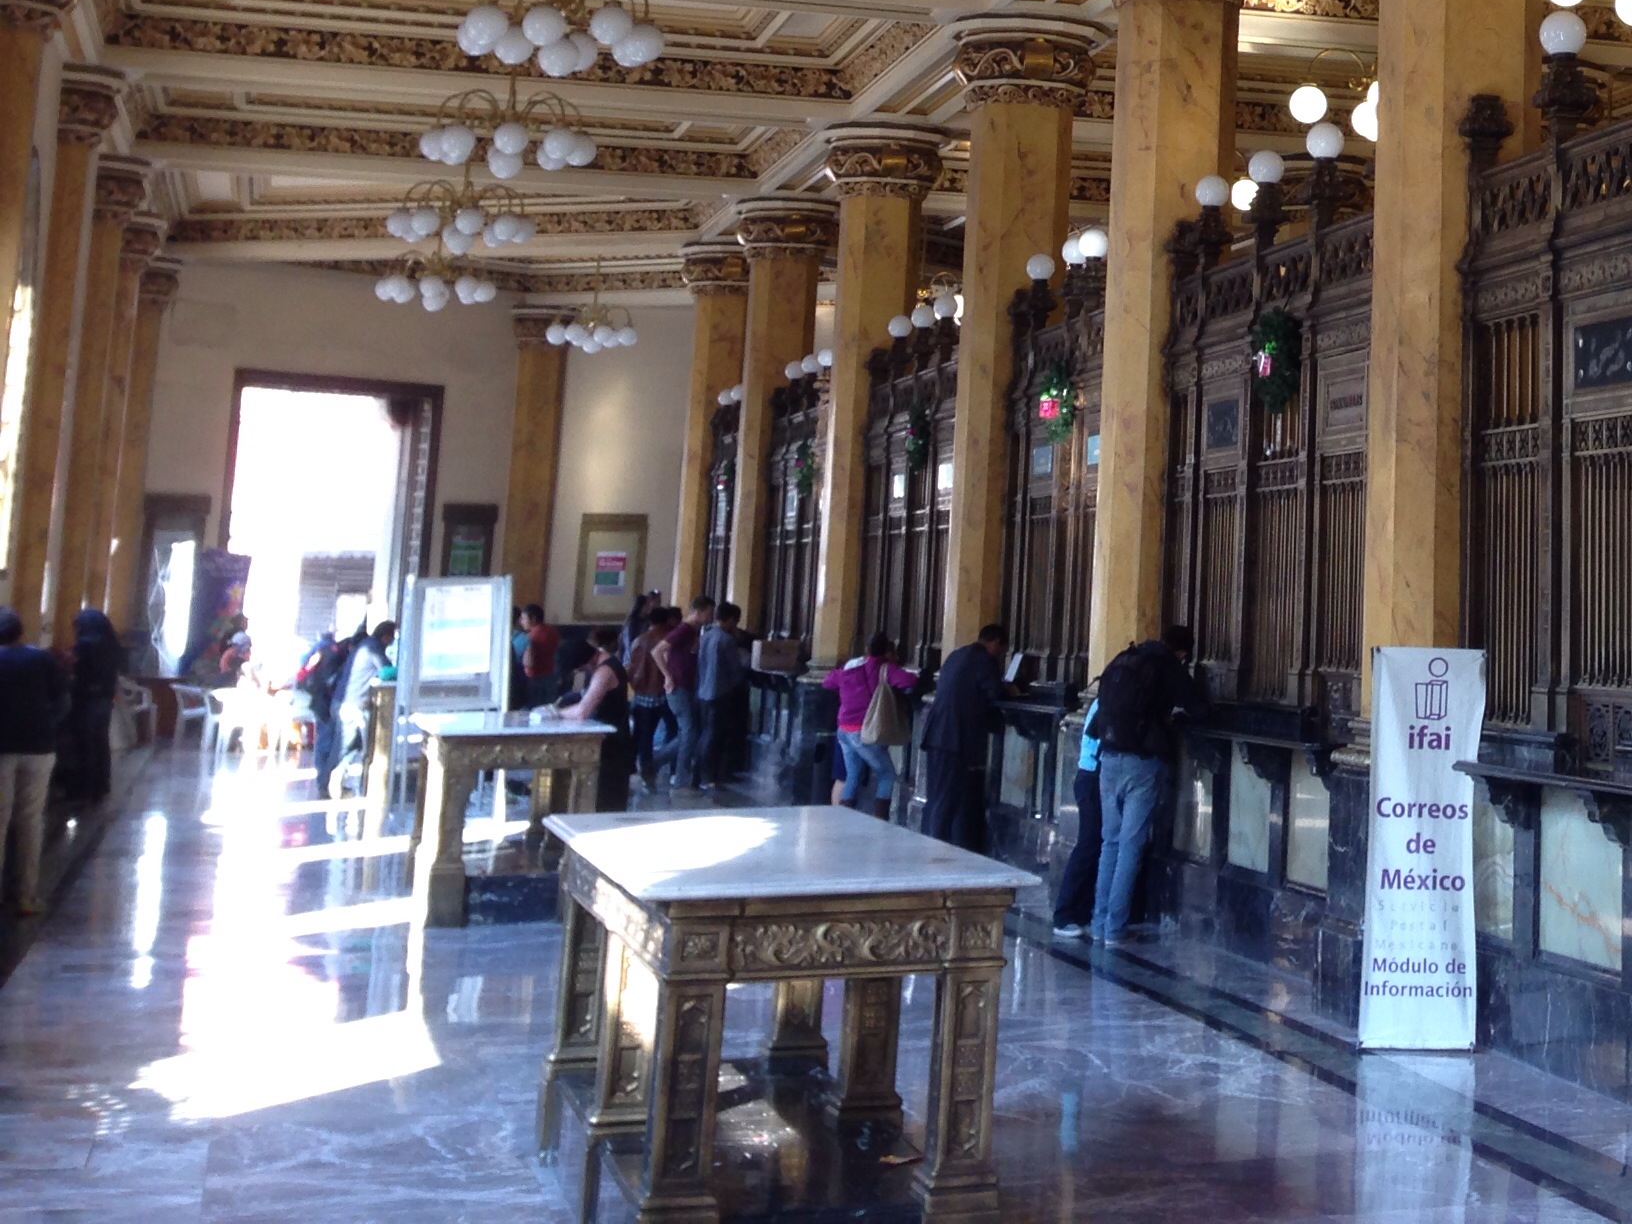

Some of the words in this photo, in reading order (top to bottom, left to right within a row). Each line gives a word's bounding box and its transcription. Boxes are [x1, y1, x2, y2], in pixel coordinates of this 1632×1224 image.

[1408, 725, 1451, 750] ifai
[1376, 797, 1469, 820] Correos
[1406, 832, 1436, 854] de
[1380, 868, 1466, 891] México
[1372, 957, 1438, 974] Módulo
[1445, 958, 1467, 975] de
[1364, 980, 1472, 998] Información
